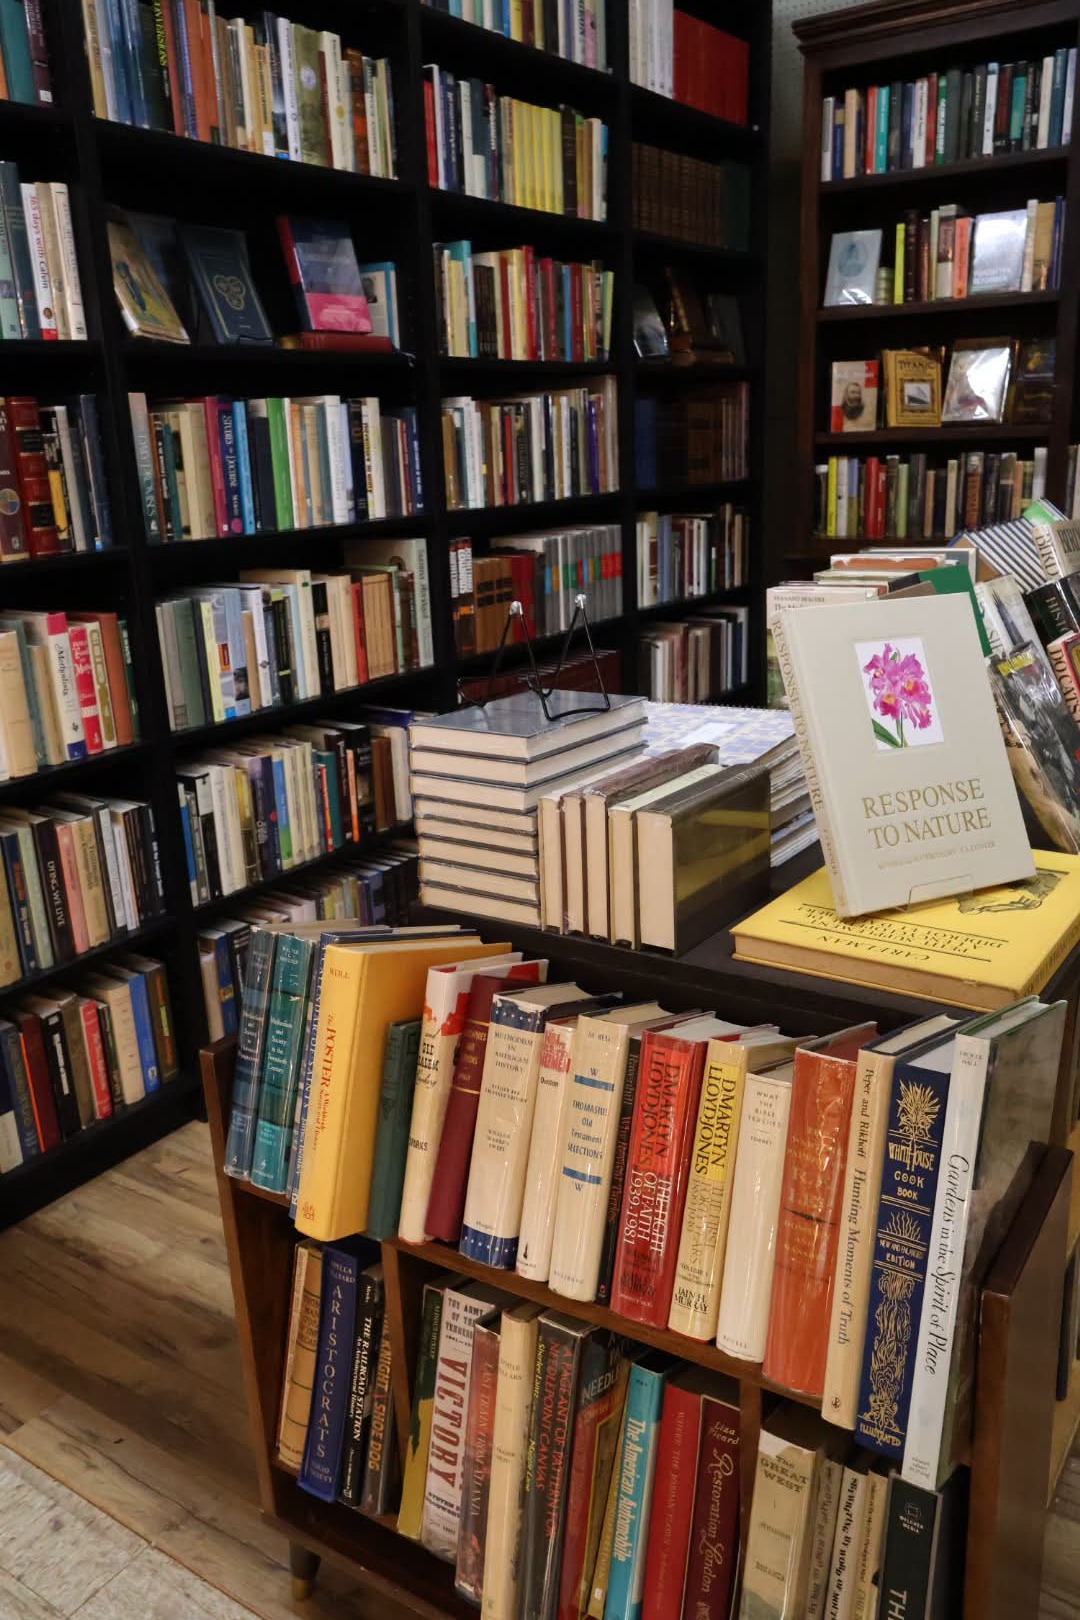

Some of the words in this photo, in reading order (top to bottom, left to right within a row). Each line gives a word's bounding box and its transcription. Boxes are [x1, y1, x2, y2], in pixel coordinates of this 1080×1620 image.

[40, 260, 50, 289] Calvin
[772, 619, 801, 708] RESPONSE
[799, 737, 825, 813] NATURE
[861, 778, 985, 819] RESPONSE
[868, 824, 900, 849] TO
[903, 807, 992, 843] NATURE
[494, 1031, 534, 1047] METHODISM
[507, 1044, 517, 1052] IN
[320, 1027, 337, 1090] POSTER
[494, 1050, 530, 1065] AMERICAN
[494, 1060, 524, 1074] HISTORY
[589, 1067, 599, 1077] W
[756, 1091, 779, 1101] WHAT
[860, 1098, 870, 1118] and
[581, 1117, 593, 1128] Old
[754, 1107, 775, 1118] BIBLE
[571, 1128, 603, 1144] Testament
[567, 1143, 604, 1160] SELECTIONS
[574, 1182, 584, 1193] W
[643, 1171, 658, 1193] OF
[893, 1170, 925, 1189] COOK
[941, 1153, 971, 1223] Gardens
[848, 1167, 867, 1225] Hunting
[896, 1186, 918, 1201] BOOK
[637, 1194, 656, 1242] FAITH
[941, 1226, 955, 1239] in
[842, 1227, 861, 1289] Moments
[885, 1252, 916, 1270] EDITION
[937, 1239, 954, 1264] the
[841, 1291, 852, 1308] of
[929, 1266, 957, 1315] Spirit
[448, 1297, 461, 1310] THE
[463, 1304, 484, 1317] ARMY
[674, 1294, 708, 1313] MURRAY
[363, 1316, 372, 1340] THE
[451, 1312, 461, 1322] OF
[838, 1309, 853, 1346] Truth
[928, 1313, 944, 1334] of
[376, 1339, 392, 1393] KNIGHT
[923, 1331, 949, 1376] Place
[316, 1284, 343, 1459] ARISTOCRATS
[357, 1340, 370, 1394] RAILROAD
[541, 1341, 563, 1430] NEEDLEPOINT
[557, 1363, 575, 1428] PAGEANT
[582, 1368, 622, 1400] NEEDL
[353, 1395, 364, 1442] STATION
[372, 1402, 387, 1440] SHOE
[429, 1356, 468, 1489] VICTORY
[627, 1416, 647, 1440] The
[714, 1420, 736, 1437] Liza
[553, 1428, 566, 1448] OF
[859, 1422, 901, 1447] ILLUSTRATED
[368, 1440, 382, 1472] DOG
[536, 1433, 551, 1492] CANVAS
[775, 1454, 796, 1469] The
[620, 1441, 644, 1497] American
[760, 1457, 809, 1485] GREAT
[763, 1468, 804, 1493] WEST
[705, 1448, 735, 1539] Restoration
[613, 1495, 638, 1563] Automobile
[699, 1529, 725, 1594] London
